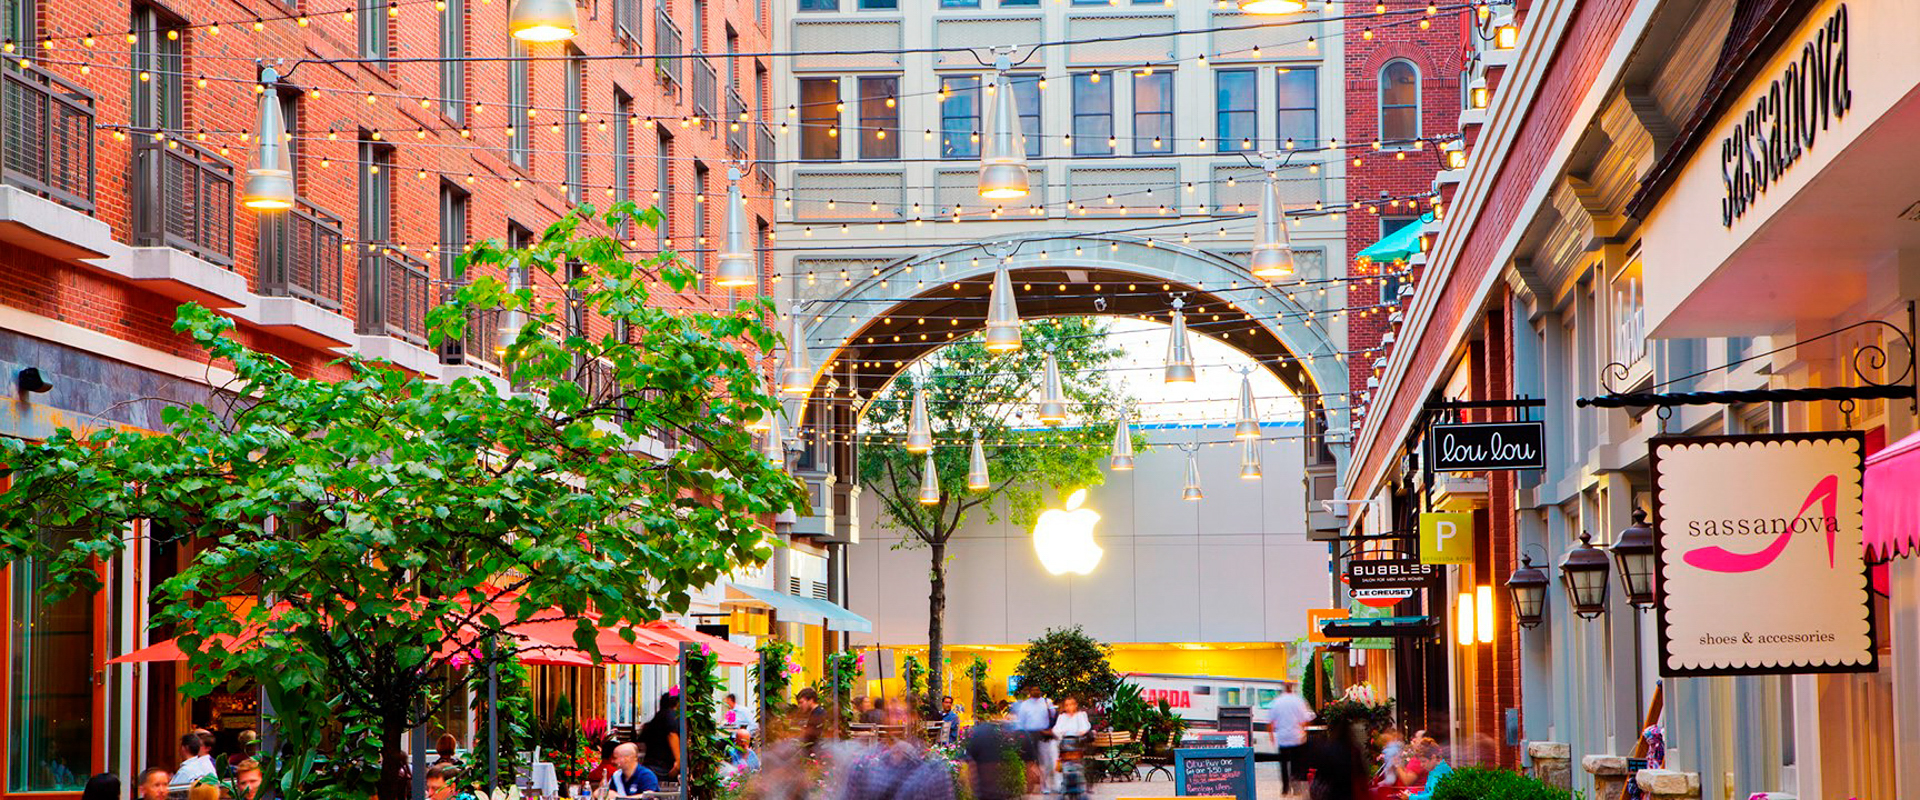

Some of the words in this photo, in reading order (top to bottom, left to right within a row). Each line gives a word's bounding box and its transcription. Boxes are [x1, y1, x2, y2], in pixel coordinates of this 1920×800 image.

[1721, 3, 1851, 228] sassanova
[1441, 433, 1488, 462] lou
[1491, 432, 1536, 461] lou
[1437, 521, 1457, 552] P
[1688, 515, 1841, 537] sassanova
[1353, 564, 1431, 576] BUBBLES
[1699, 633, 1738, 645] shoes
[1741, 632, 1754, 644] &
[1758, 630, 1835, 643] accessories
